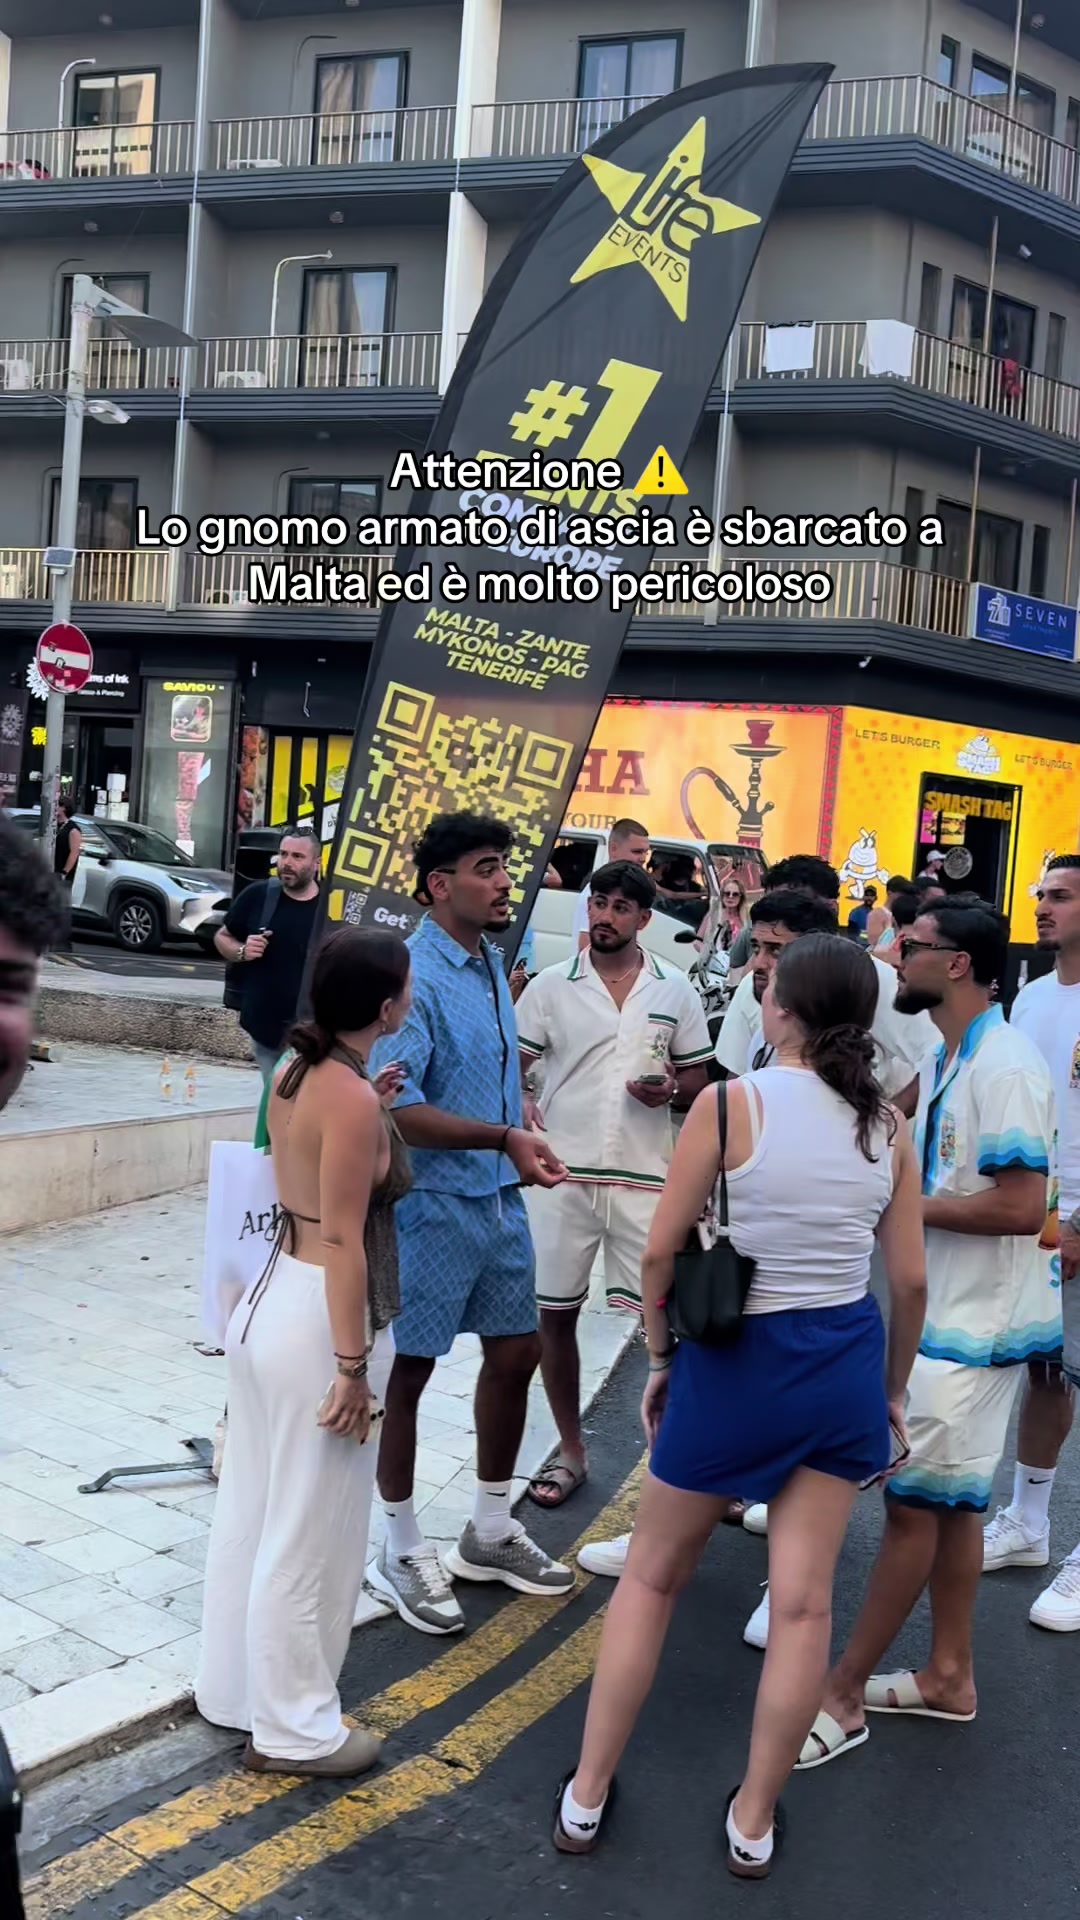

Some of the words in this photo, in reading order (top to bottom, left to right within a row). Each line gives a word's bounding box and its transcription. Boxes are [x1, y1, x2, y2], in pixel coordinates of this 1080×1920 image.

[608, 223, 687, 283] EVENTS
[508, 358, 663, 465] #1
[425, 606, 500, 640] MALTA
[515, 629, 591, 661] ZANTE
[1015, 603, 1068, 629] SEVEN
[413, 623, 528, 665] MYKONOS
[540, 656, 590, 679] PAG
[446, 651, 550, 690] TENERIFE
[104, 673, 116, 684] of
[855, 729, 888, 742] LET'S
[890, 733, 941, 749] BURGER
[923, 790, 982, 817] SMASH
[983, 798, 1013, 822] TAG
